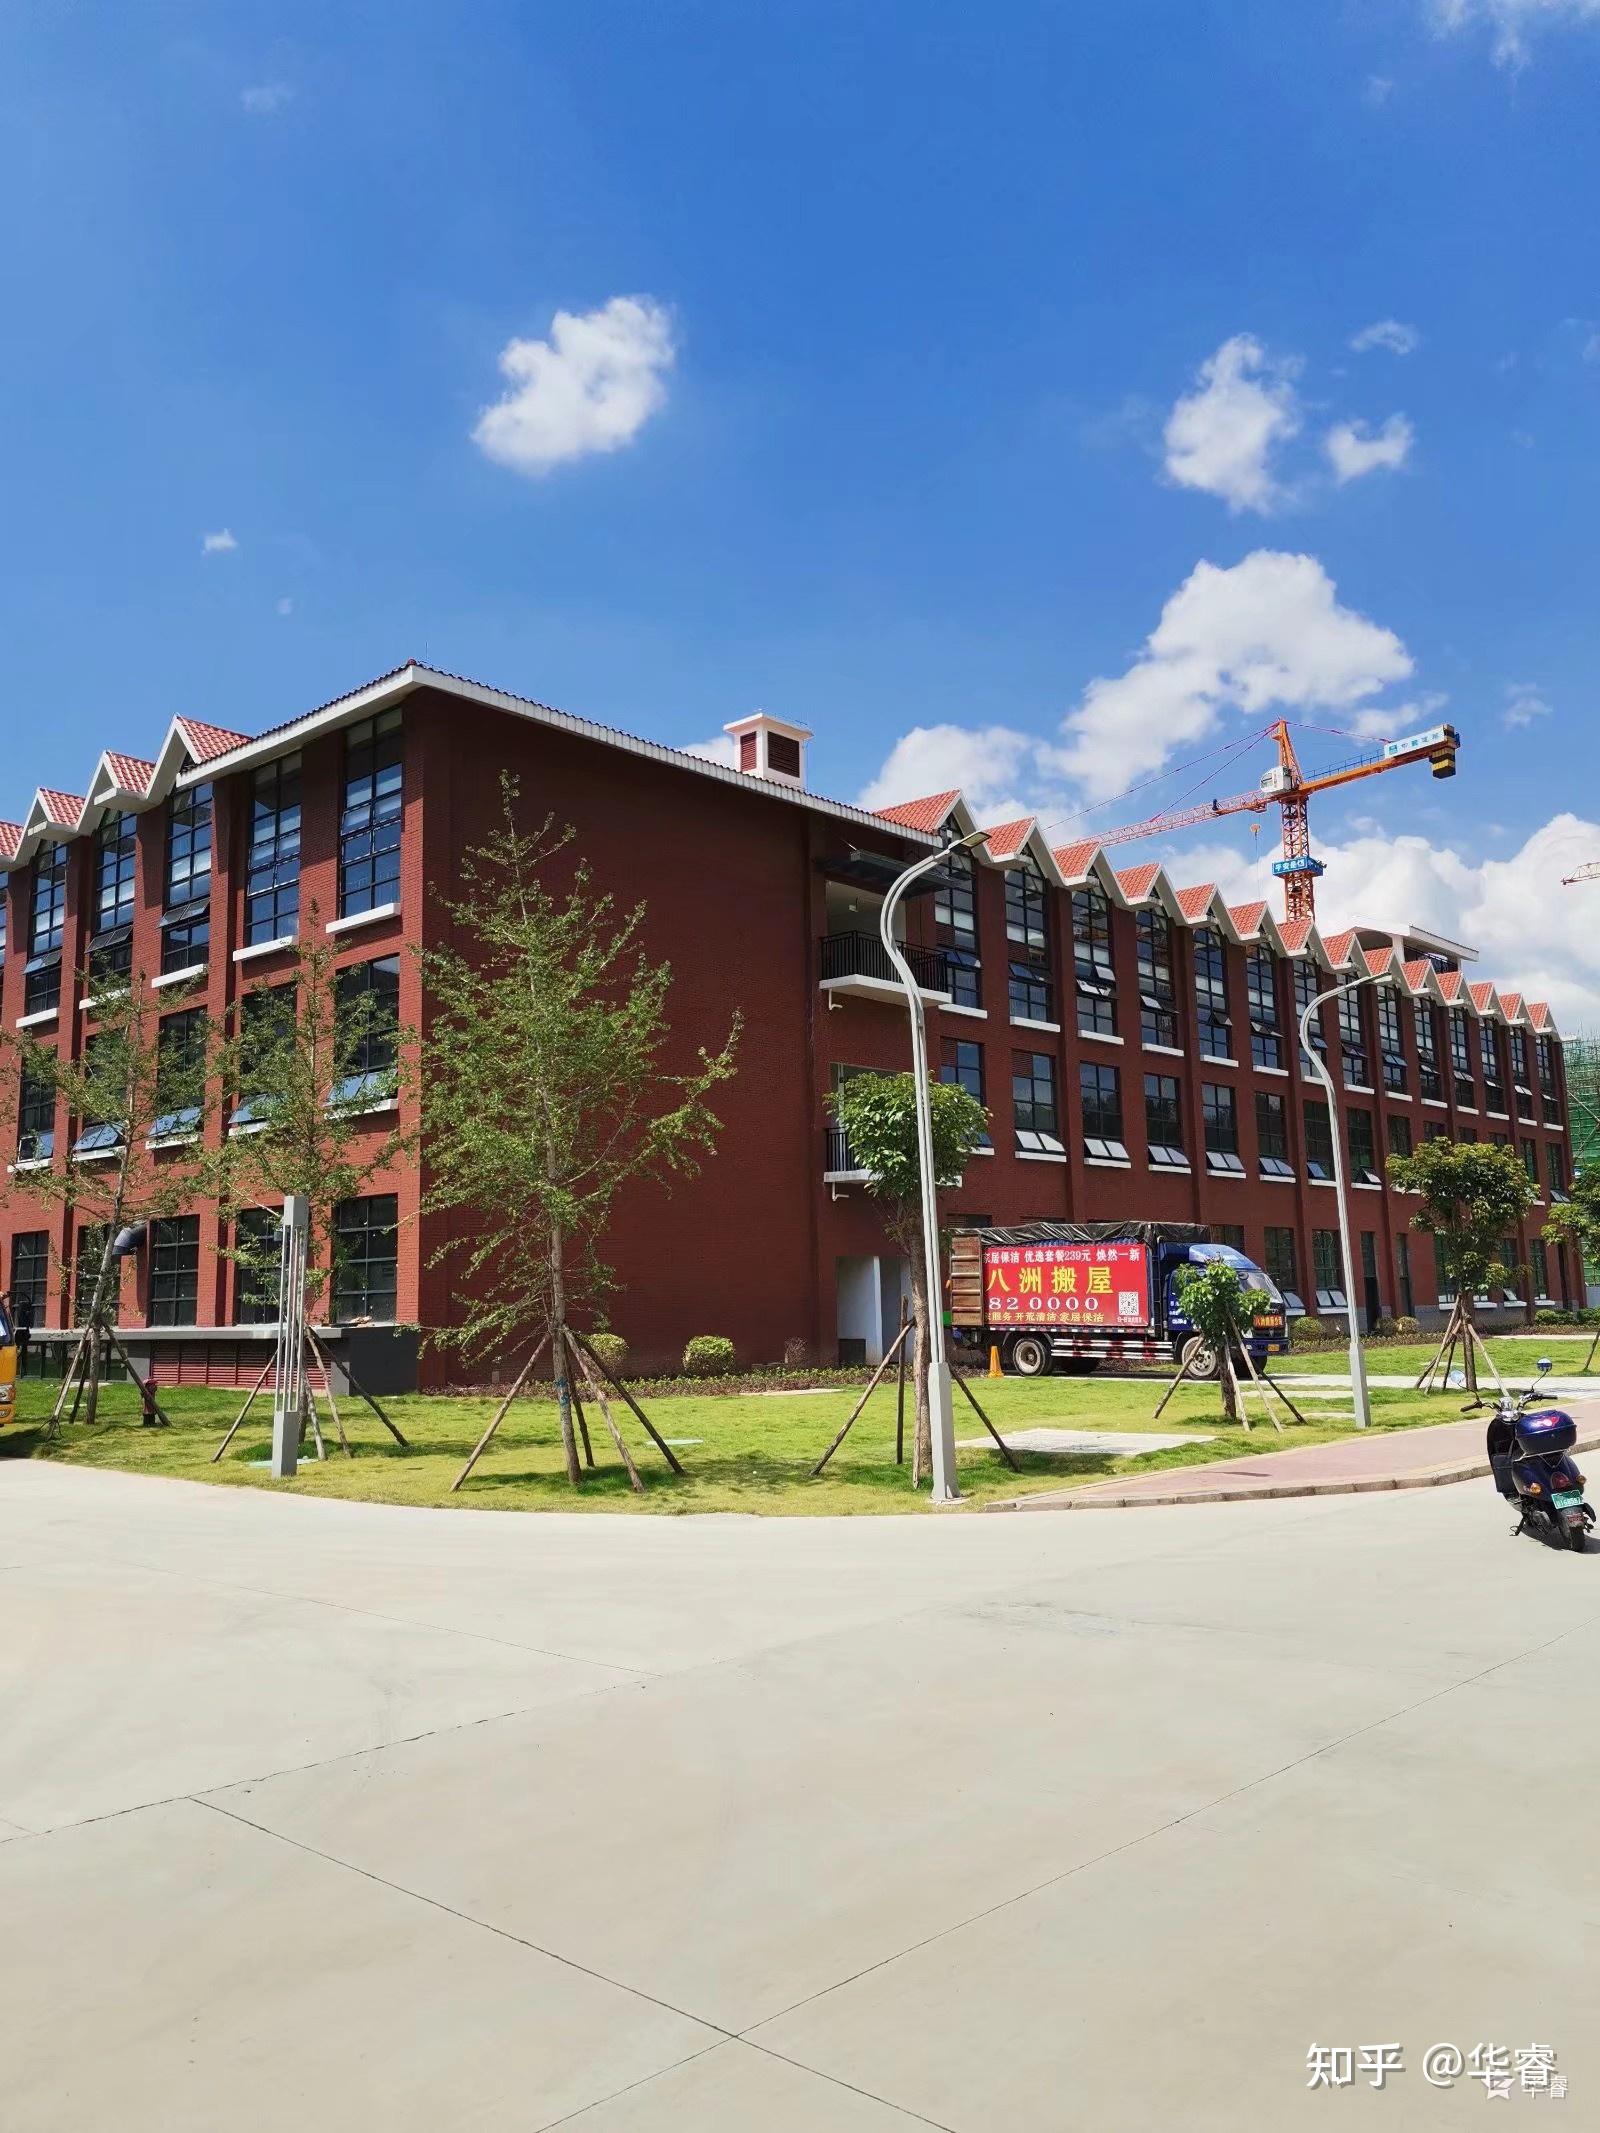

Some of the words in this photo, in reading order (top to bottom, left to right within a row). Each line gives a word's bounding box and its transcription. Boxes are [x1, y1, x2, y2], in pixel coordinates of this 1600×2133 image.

[1096, 1248, 1141, 1262] 焕然一新
[986, 1266, 1114, 1294] 八洲搬屋
